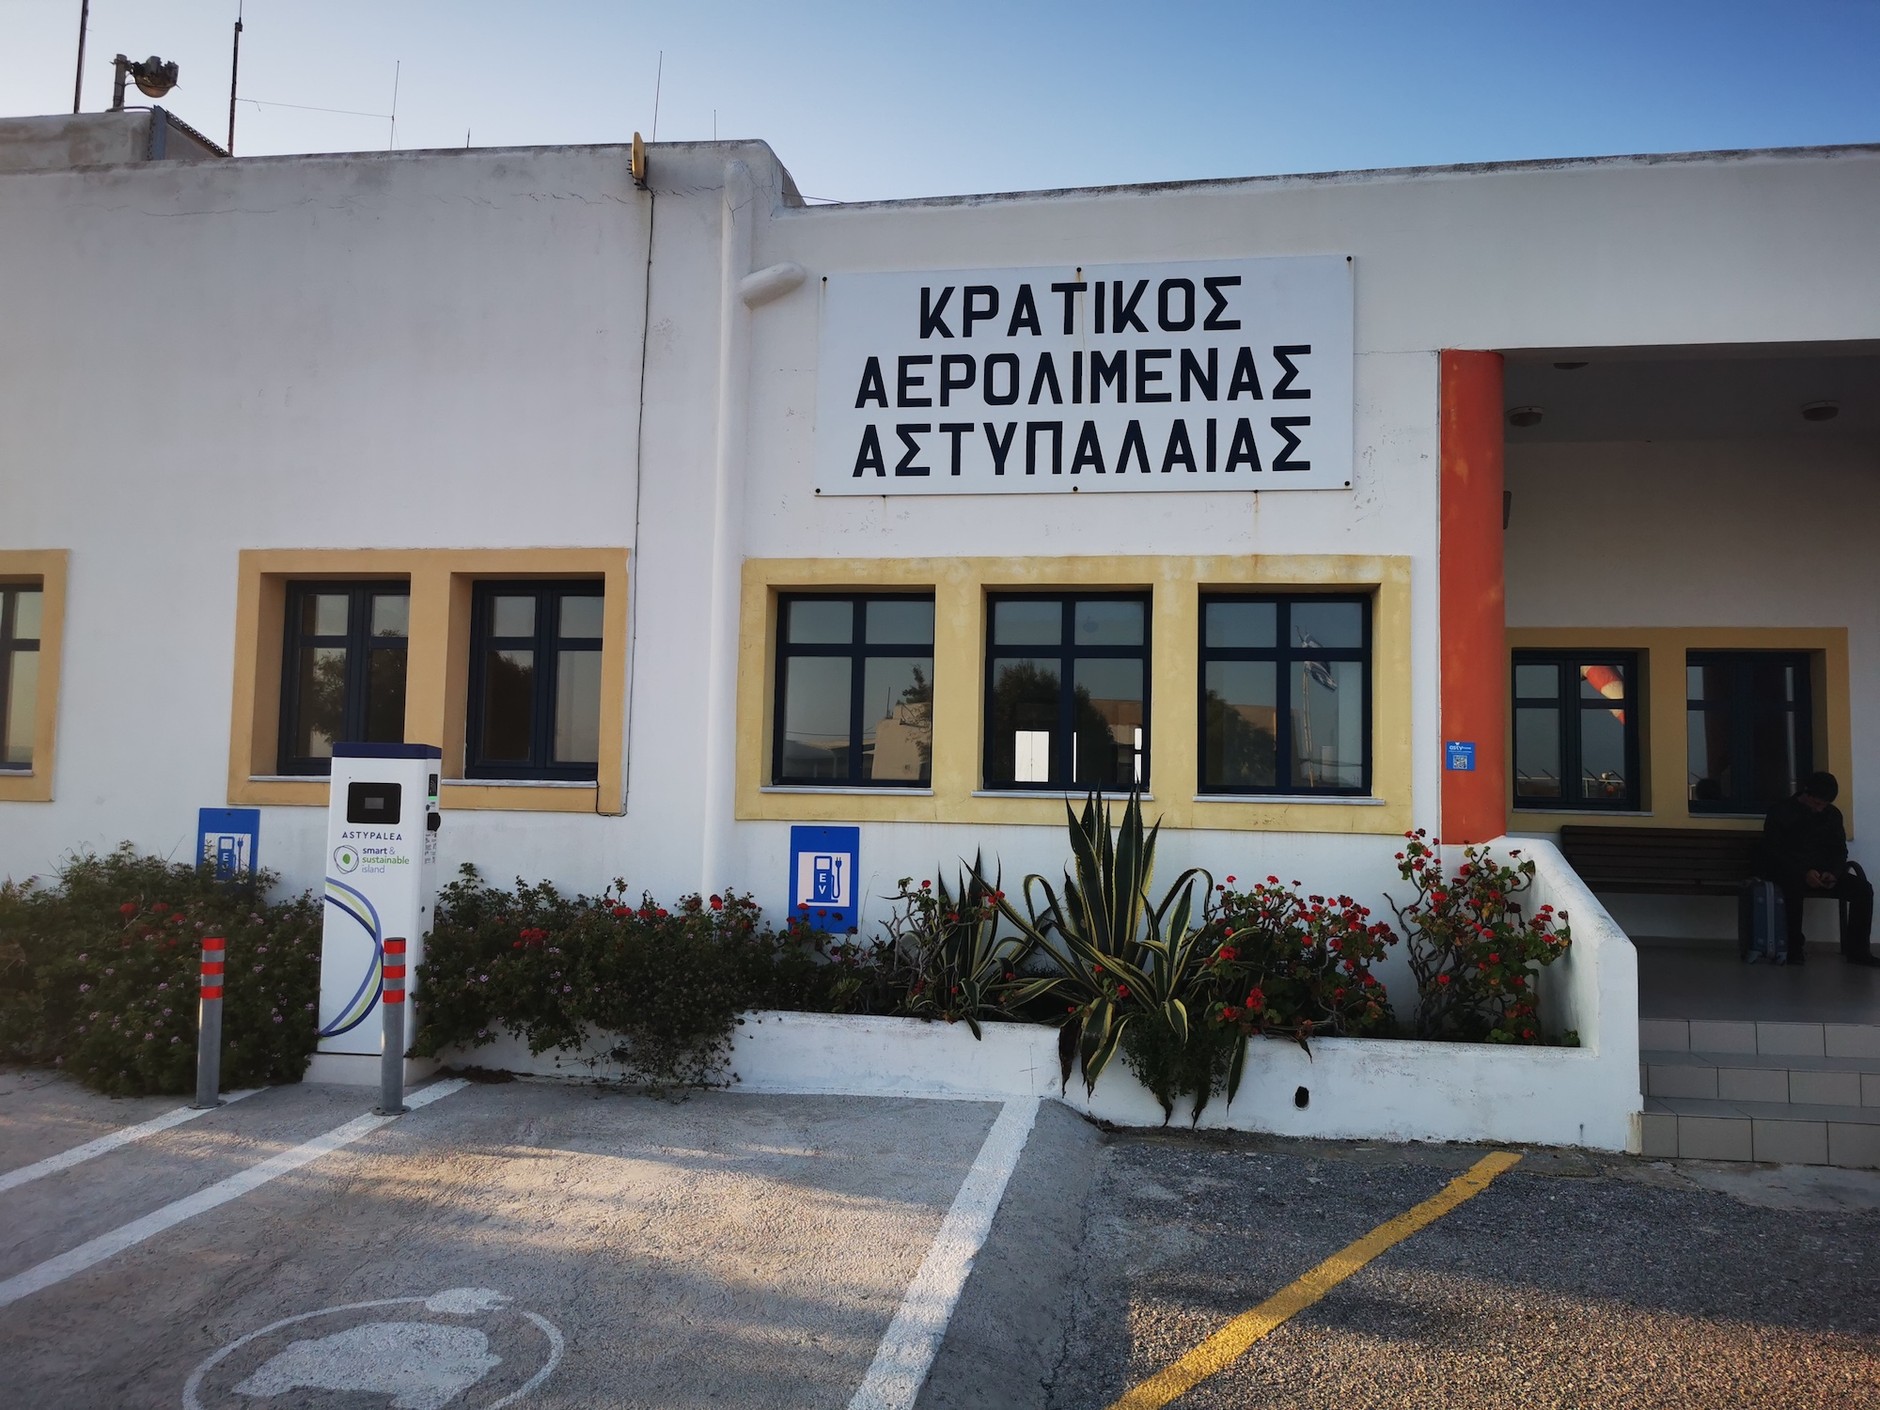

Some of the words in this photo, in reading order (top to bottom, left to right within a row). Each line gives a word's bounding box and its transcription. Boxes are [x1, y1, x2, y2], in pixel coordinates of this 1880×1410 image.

[919, 275, 1242, 339] ΚΡΑΤΙΚΟΣ
[854, 344, 1312, 409] ΑΕΡΟΛΙΜΕΝΑΣ
[852, 416, 1311, 478] ΑΣΤΥΠΑΛΑΙΑΣ
[341, 831, 403, 841] ASTYPALEA
[362, 846, 388, 855] smart
[389, 847, 396, 855] &
[362, 856, 410, 865] sustainable
[361, 865, 386, 874] island
